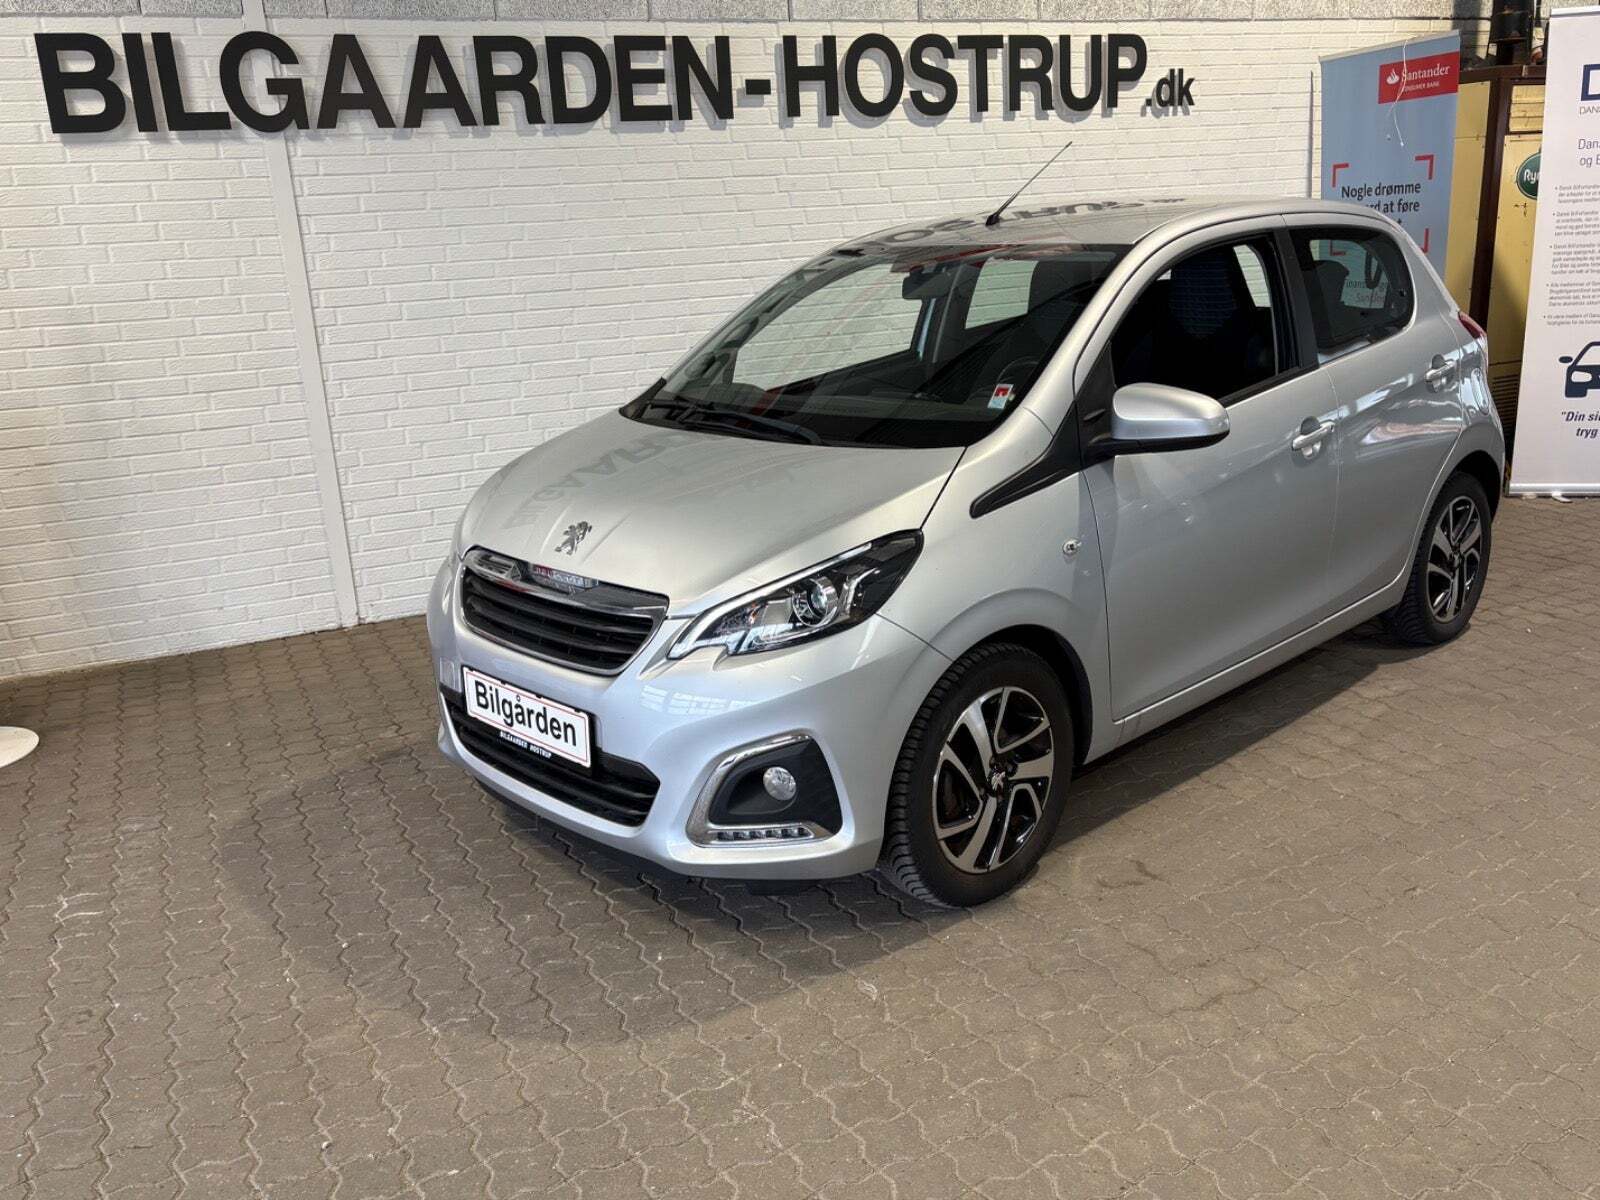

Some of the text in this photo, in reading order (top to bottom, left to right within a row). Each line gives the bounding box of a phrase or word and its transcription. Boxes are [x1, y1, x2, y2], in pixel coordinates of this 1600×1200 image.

[1402, 63, 1451, 81] Santander
[34, 31, 1195, 134] BILGAARDEN-HOSTRUP.dk
[1578, 139, 1600, 149] Dan
[1580, 157, 1592, 168] og
[1341, 182, 1421, 200] Nogle drømme
[1383, 201, 1395, 213] at
[1397, 199, 1420, 213] føre
[1576, 428, 1599, 439] tryg
[475, 680, 577, 747] Bilgården
